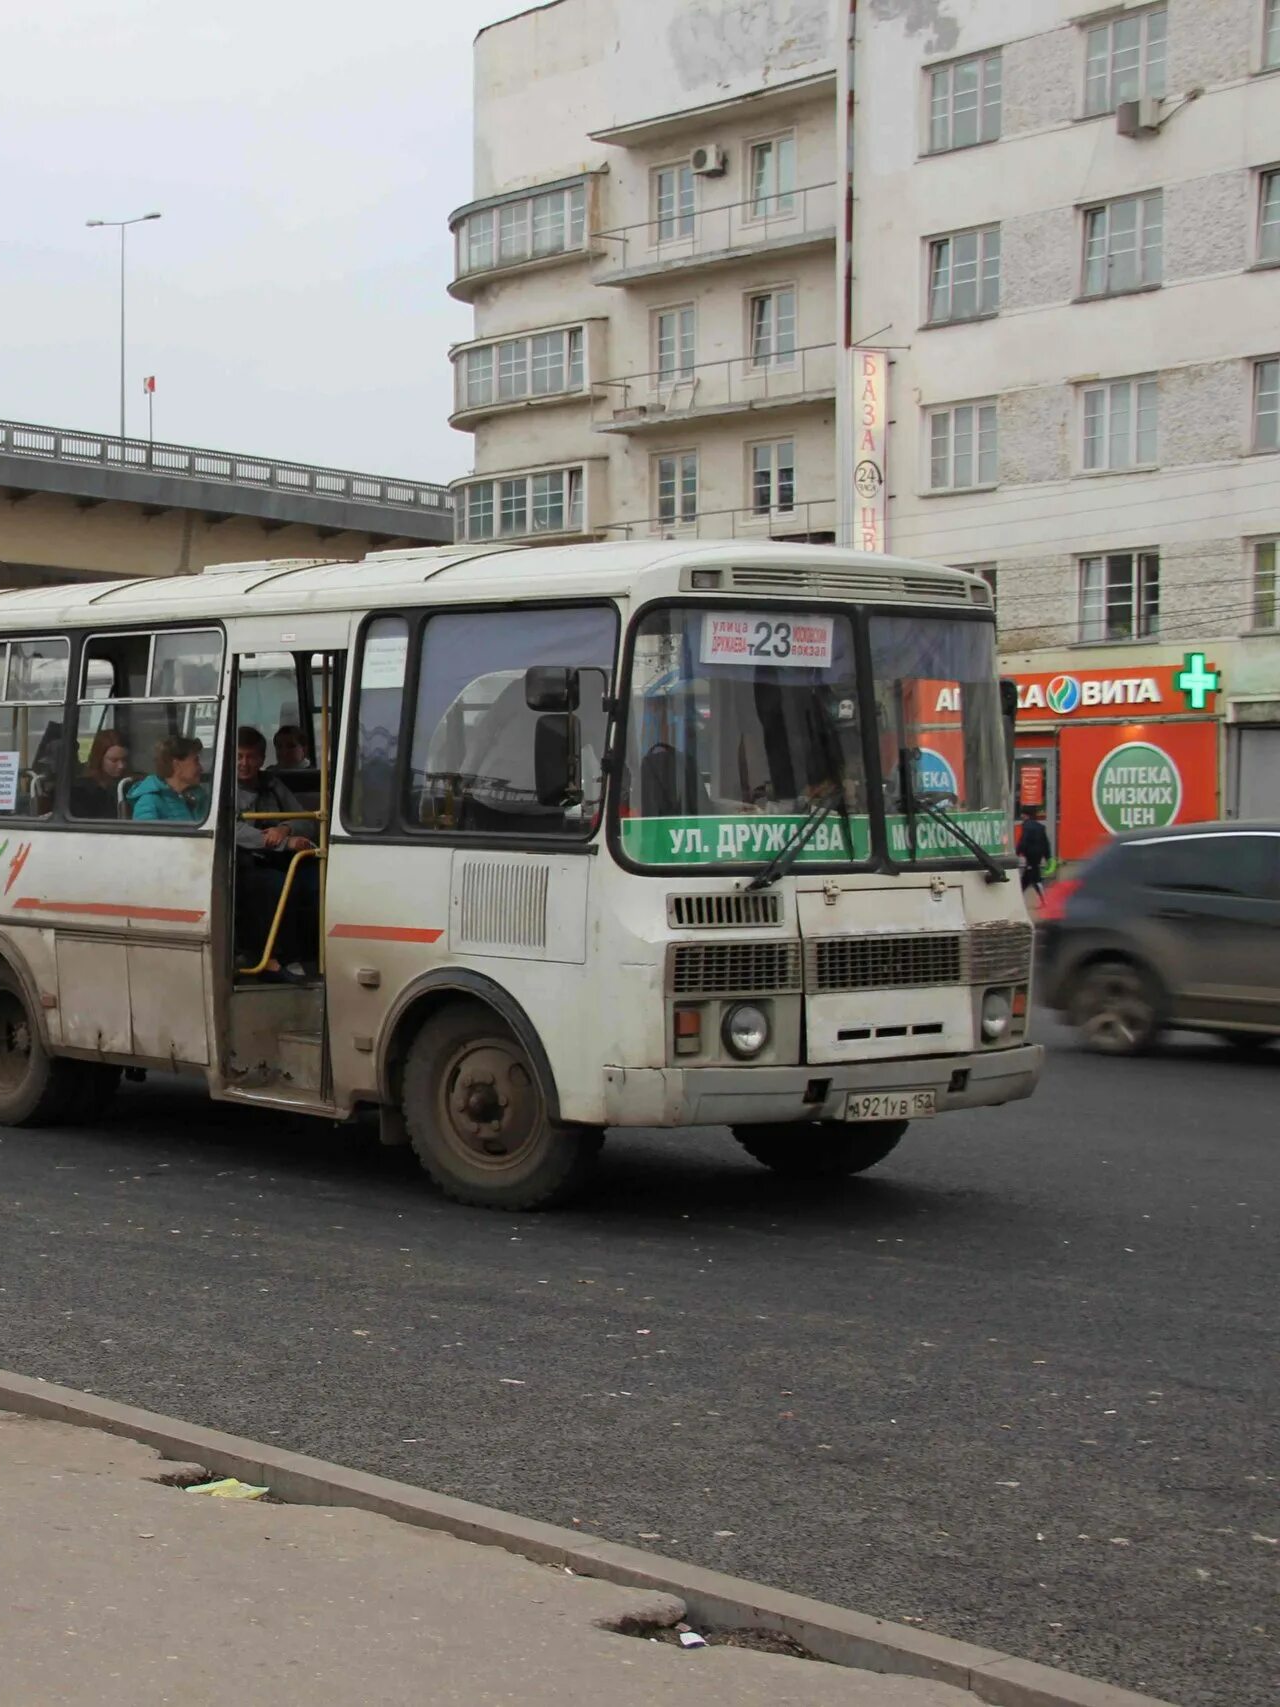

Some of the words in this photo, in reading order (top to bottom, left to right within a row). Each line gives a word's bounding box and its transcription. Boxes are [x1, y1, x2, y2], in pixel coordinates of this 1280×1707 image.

[861, 355, 877, 451] БАЗА
[858, 467, 877, 483] 24
[712, 620, 748, 635] улица
[1082, 678, 1161, 706] ВИТА
[1104, 766, 1171, 785] АПТЕКА
[1102, 786, 1172, 805] НИЗКИХ
[1120, 807, 1155, 828] ЦЕН
[669, 828, 709, 854] УЛ.
